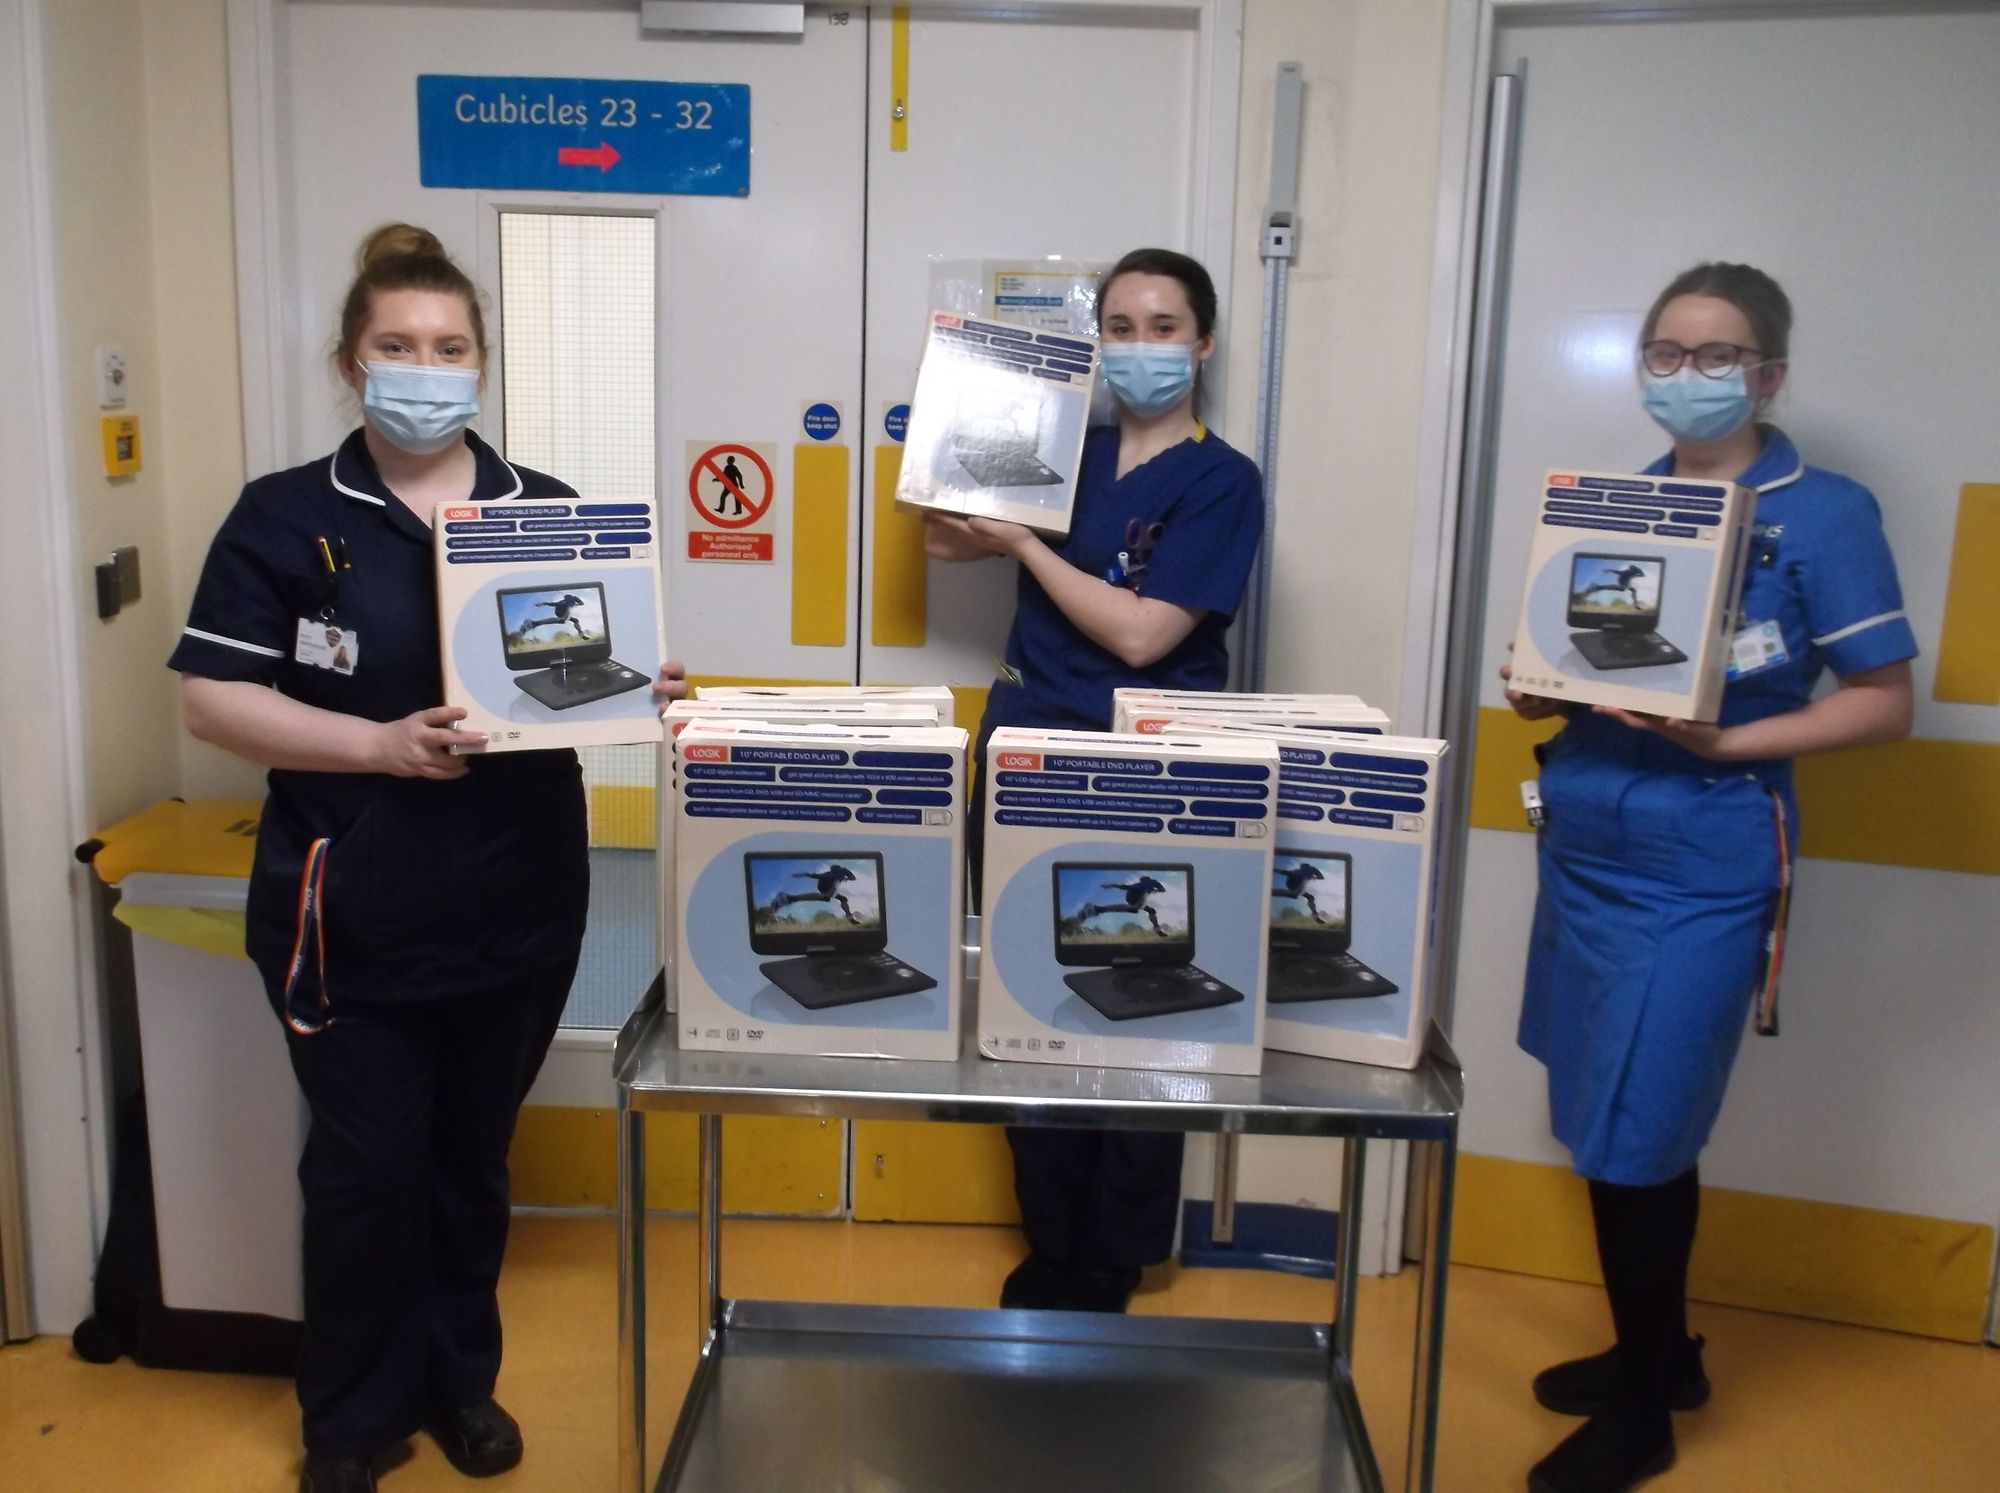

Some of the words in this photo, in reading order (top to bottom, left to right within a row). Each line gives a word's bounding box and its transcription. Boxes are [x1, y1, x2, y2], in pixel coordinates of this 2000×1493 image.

[455, 93, 588, 126] Cubicles
[600, 98, 637, 127] 23
[675, 100, 713, 130] 32
[498, 508, 530, 517] PORTABLE
[530, 507, 544, 516] DVD
[544, 507, 566, 515] PLAYER
[715, 534, 760, 542] admittance
[709, 542, 753, 550] Authorised
[701, 551, 741, 559] personnel
[742, 551, 760, 560] only
[692, 749, 721, 758] LOGIK
[740, 751, 752, 759] 10"
[753, 751, 793, 760] PORTABLE
[793, 752, 811, 760] DVD
[811, 752, 841, 761] PLAYER
[1289, 751, 1317, 761] PLAYER
[1005, 756, 1033, 767] LOGIK
[1053, 758, 1065, 768] 10"
[1065, 759, 1106, 770] PORTABLE
[1107, 761, 1125, 770] DVD
[1126, 762, 1155, 772] PLAYER
[852, 773, 865, 781] with
